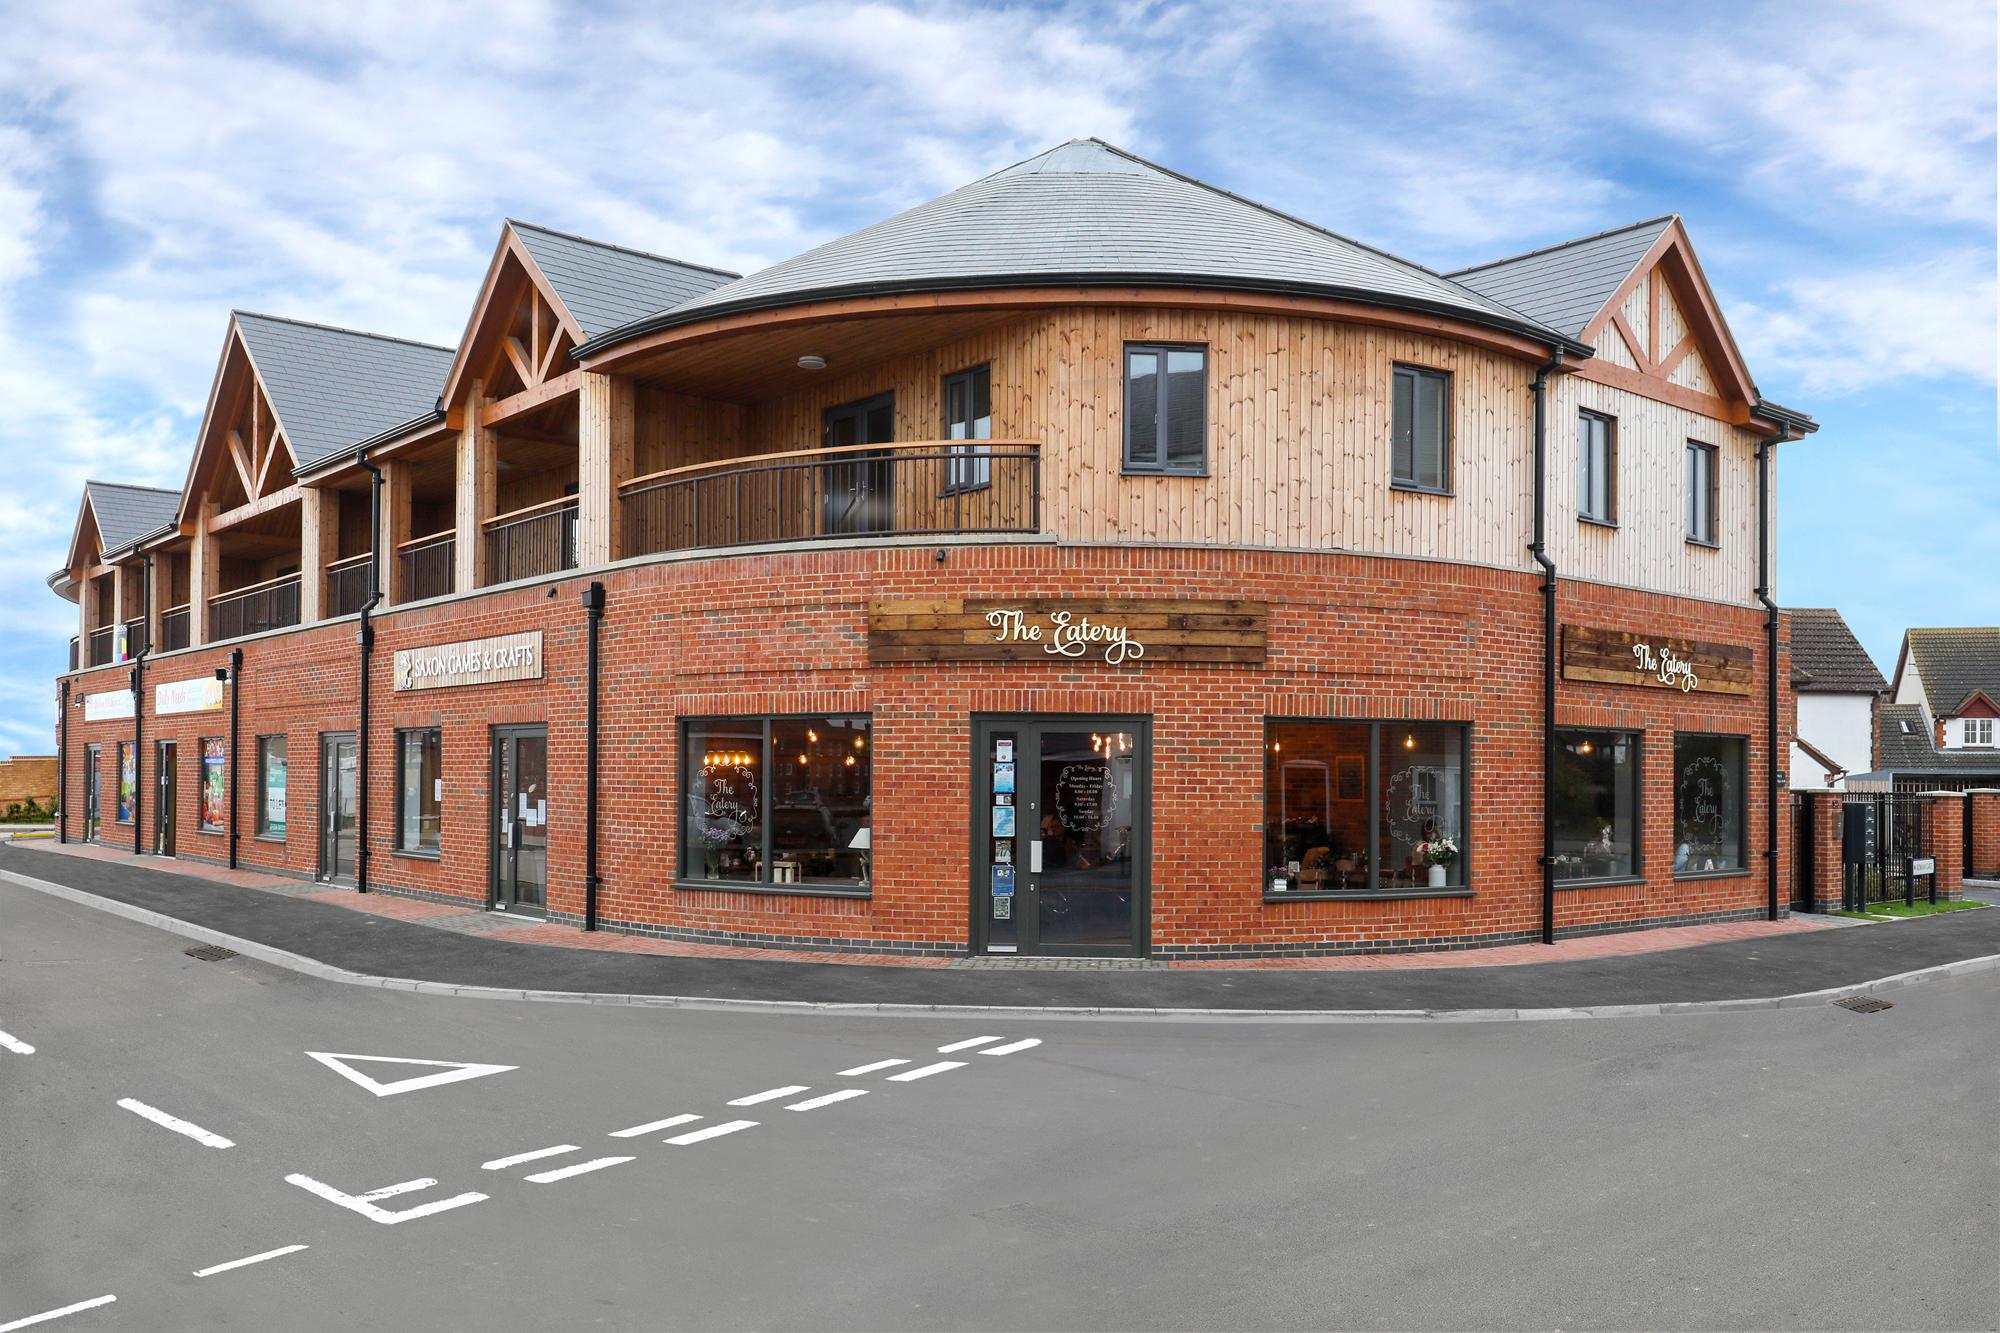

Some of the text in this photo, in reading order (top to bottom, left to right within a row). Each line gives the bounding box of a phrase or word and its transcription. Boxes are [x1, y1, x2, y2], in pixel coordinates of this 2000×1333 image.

[986, 610, 1144, 665] The Eatery
[415, 644, 534, 677] SAXON GAMES & CRAFTS
[1632, 643, 1698, 692] The Eatery
[713, 778, 734, 795] The
[1409, 783, 1431, 800] The
[1697, 777, 1713, 796] The
[705, 793, 747, 827] Eatery
[1403, 799, 1444, 832] Eatery
[1693, 796, 1724, 834] Eatery
